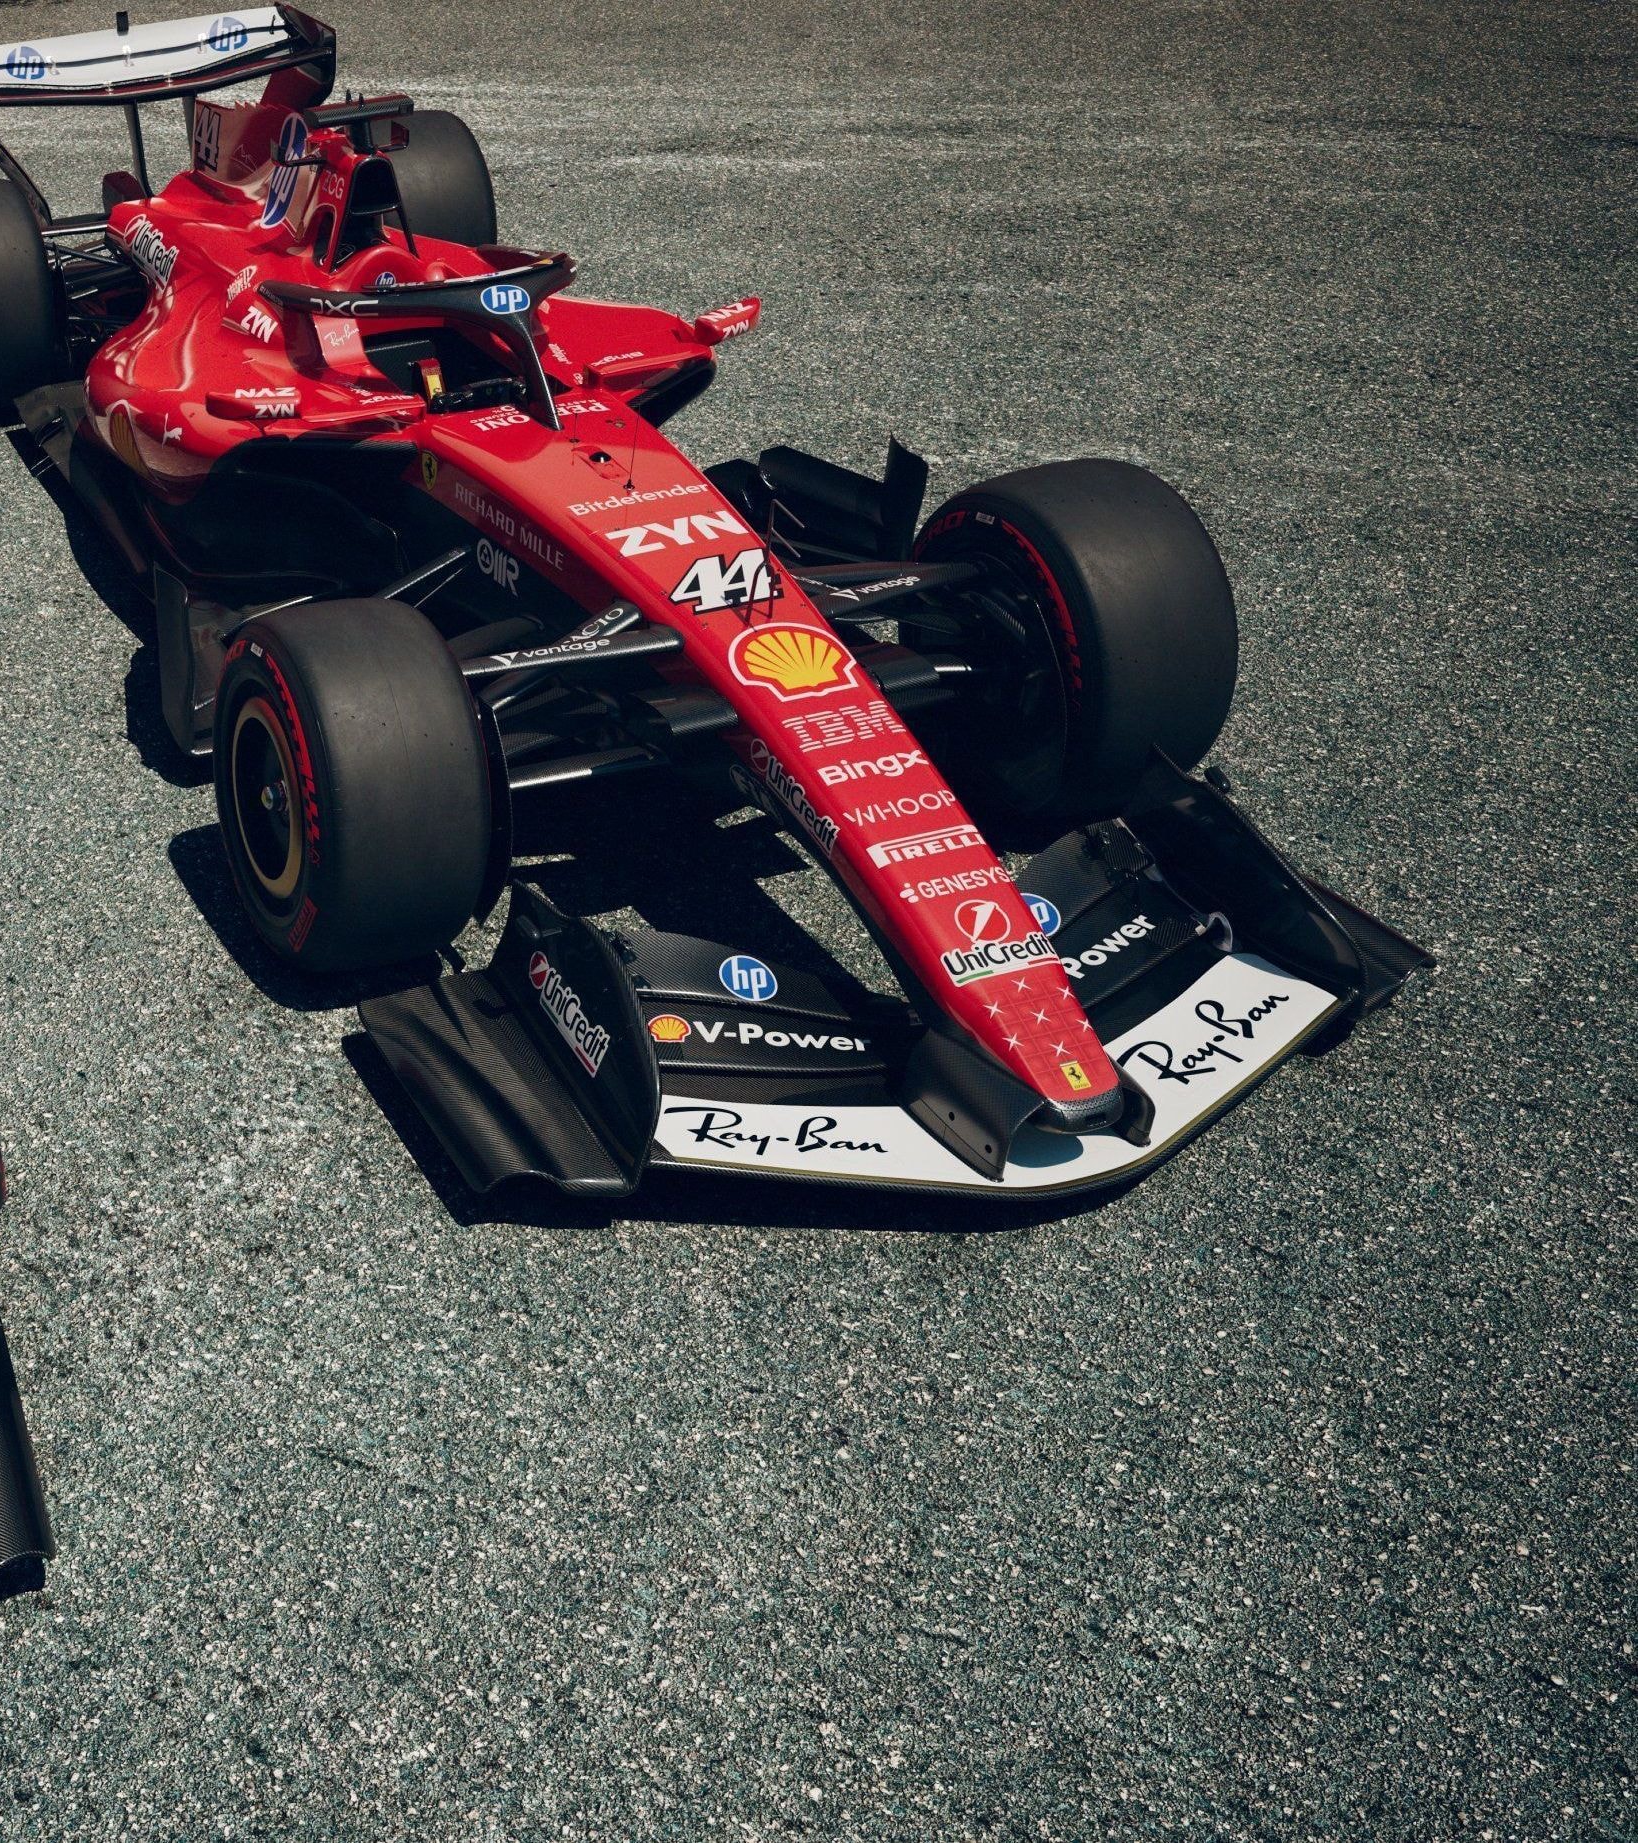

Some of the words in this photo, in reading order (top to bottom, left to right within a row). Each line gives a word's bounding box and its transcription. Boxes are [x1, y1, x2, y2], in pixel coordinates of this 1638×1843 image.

[213, 16, 244, 52] hp
[12, 46, 41, 79] hp
[194, 106, 221, 172] 44
[133, 221, 177, 281] UniCredit
[490, 285, 524, 314] hp
[241, 306, 278, 343] ZYN
[235, 387, 296, 398] ZYN
[254, 404, 295, 418] ZYN
[568, 483, 709, 516] Bitdefender
[455, 483, 515, 537] RICHARD
[519, 525, 564, 571] MILLE
[605, 510, 749, 557] ZYN
[668, 547, 785, 615] 44
[856, 576, 921, 594] vantage
[522, 638, 611, 659] vantage
[781, 700, 906, 753] IBM
[817, 750, 929, 787] BingX
[768, 756, 837, 850] UniCredit
[843, 790, 956, 827] WHOOP
[866, 824, 987, 869] PIRELLI
[917, 866, 1010, 899] GENESYS
[943, 933, 1054, 977] UniCredit
[1063, 914, 1157, 980] Power
[730, 955, 768, 1000] hp
[544, 972, 608, 1066] UniCredit
[693, 1021, 871, 1051] V-Power
[1116, 994, 1290, 1085] Ray-Ban
[664, 1106, 888, 1155] Ray-Ban
